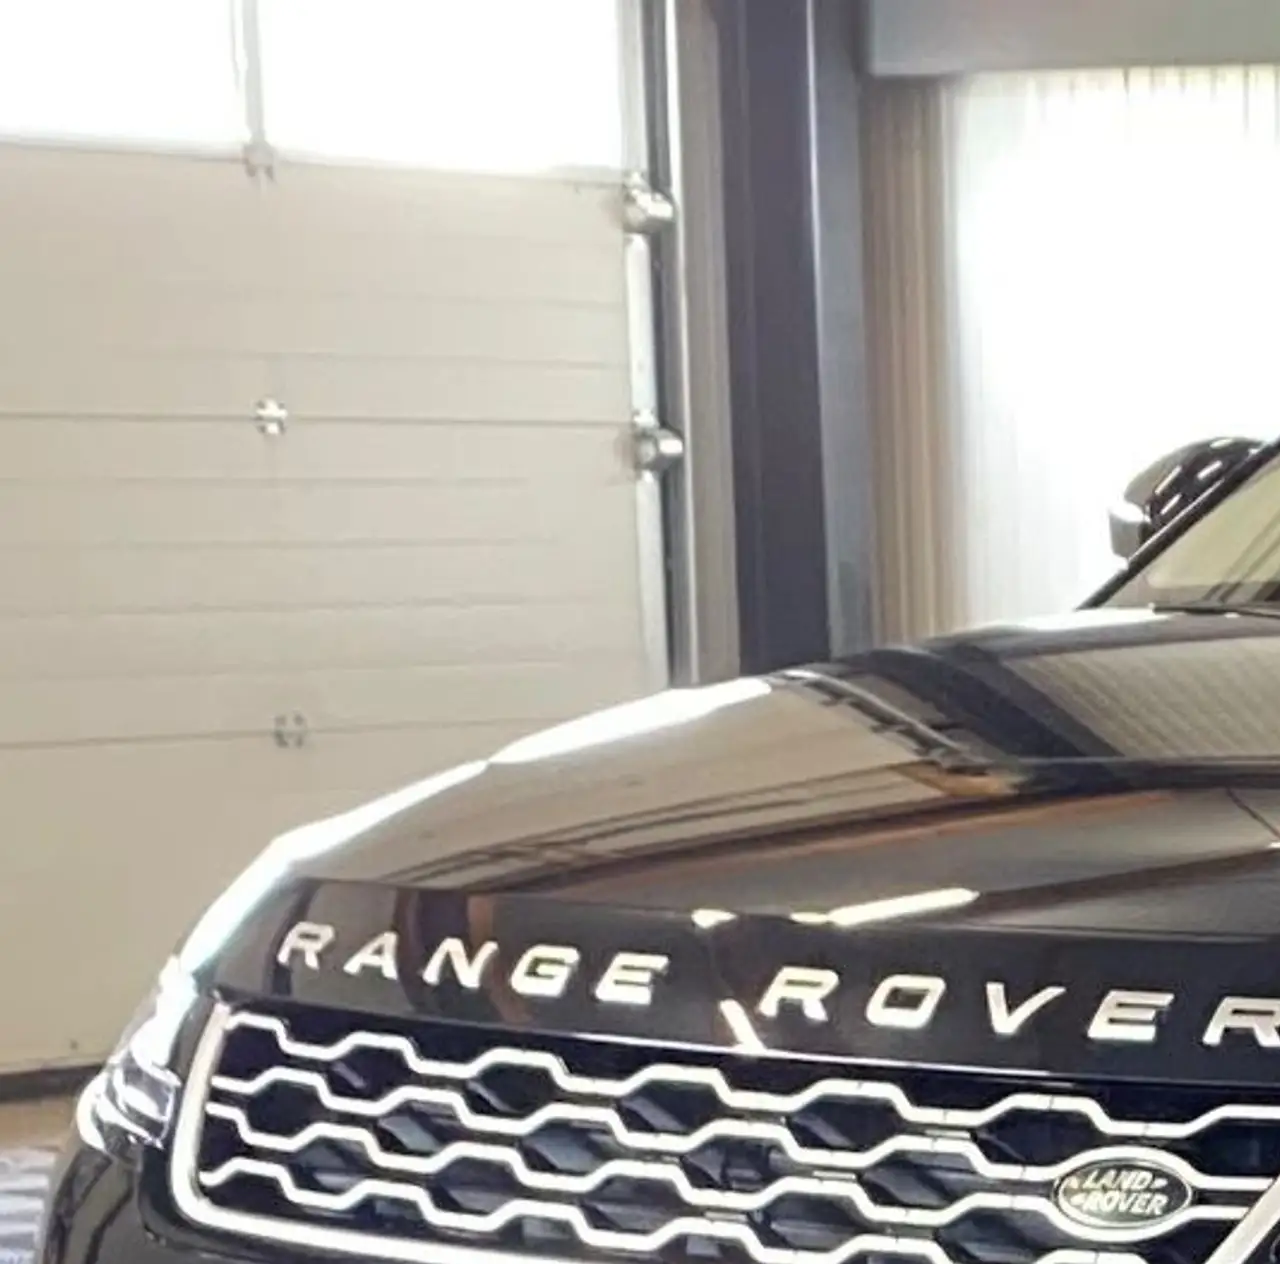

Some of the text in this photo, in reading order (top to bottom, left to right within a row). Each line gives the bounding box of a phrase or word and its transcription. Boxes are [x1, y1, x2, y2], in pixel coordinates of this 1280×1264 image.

[277, 921, 669, 1006] RANGE
[1082, 1168, 1153, 1191] LAND
[1081, 1190, 1170, 1216] ROVER
